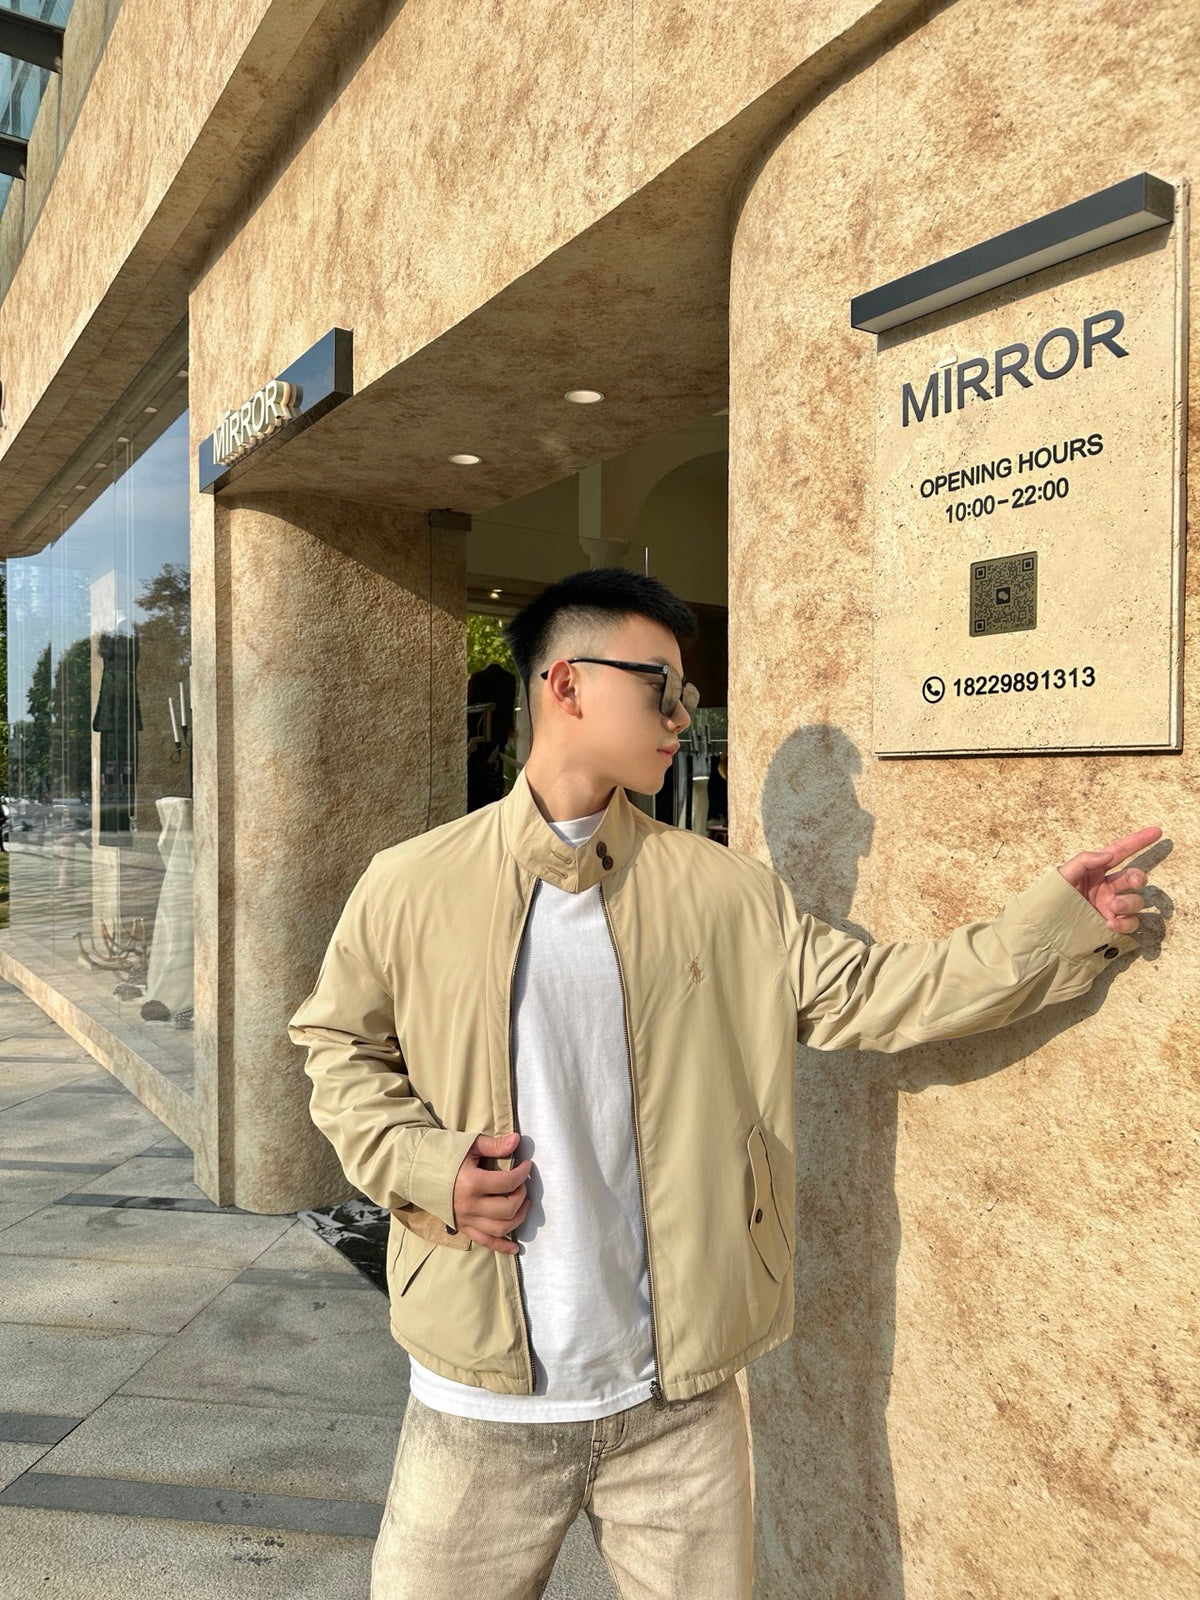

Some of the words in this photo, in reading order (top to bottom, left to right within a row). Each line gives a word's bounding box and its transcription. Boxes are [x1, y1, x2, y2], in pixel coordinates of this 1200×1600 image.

[920, 457, 1012, 498] OPENING
[1018, 433, 1104, 473] HOURS
[953, 666, 1096, 697] 18229891313
